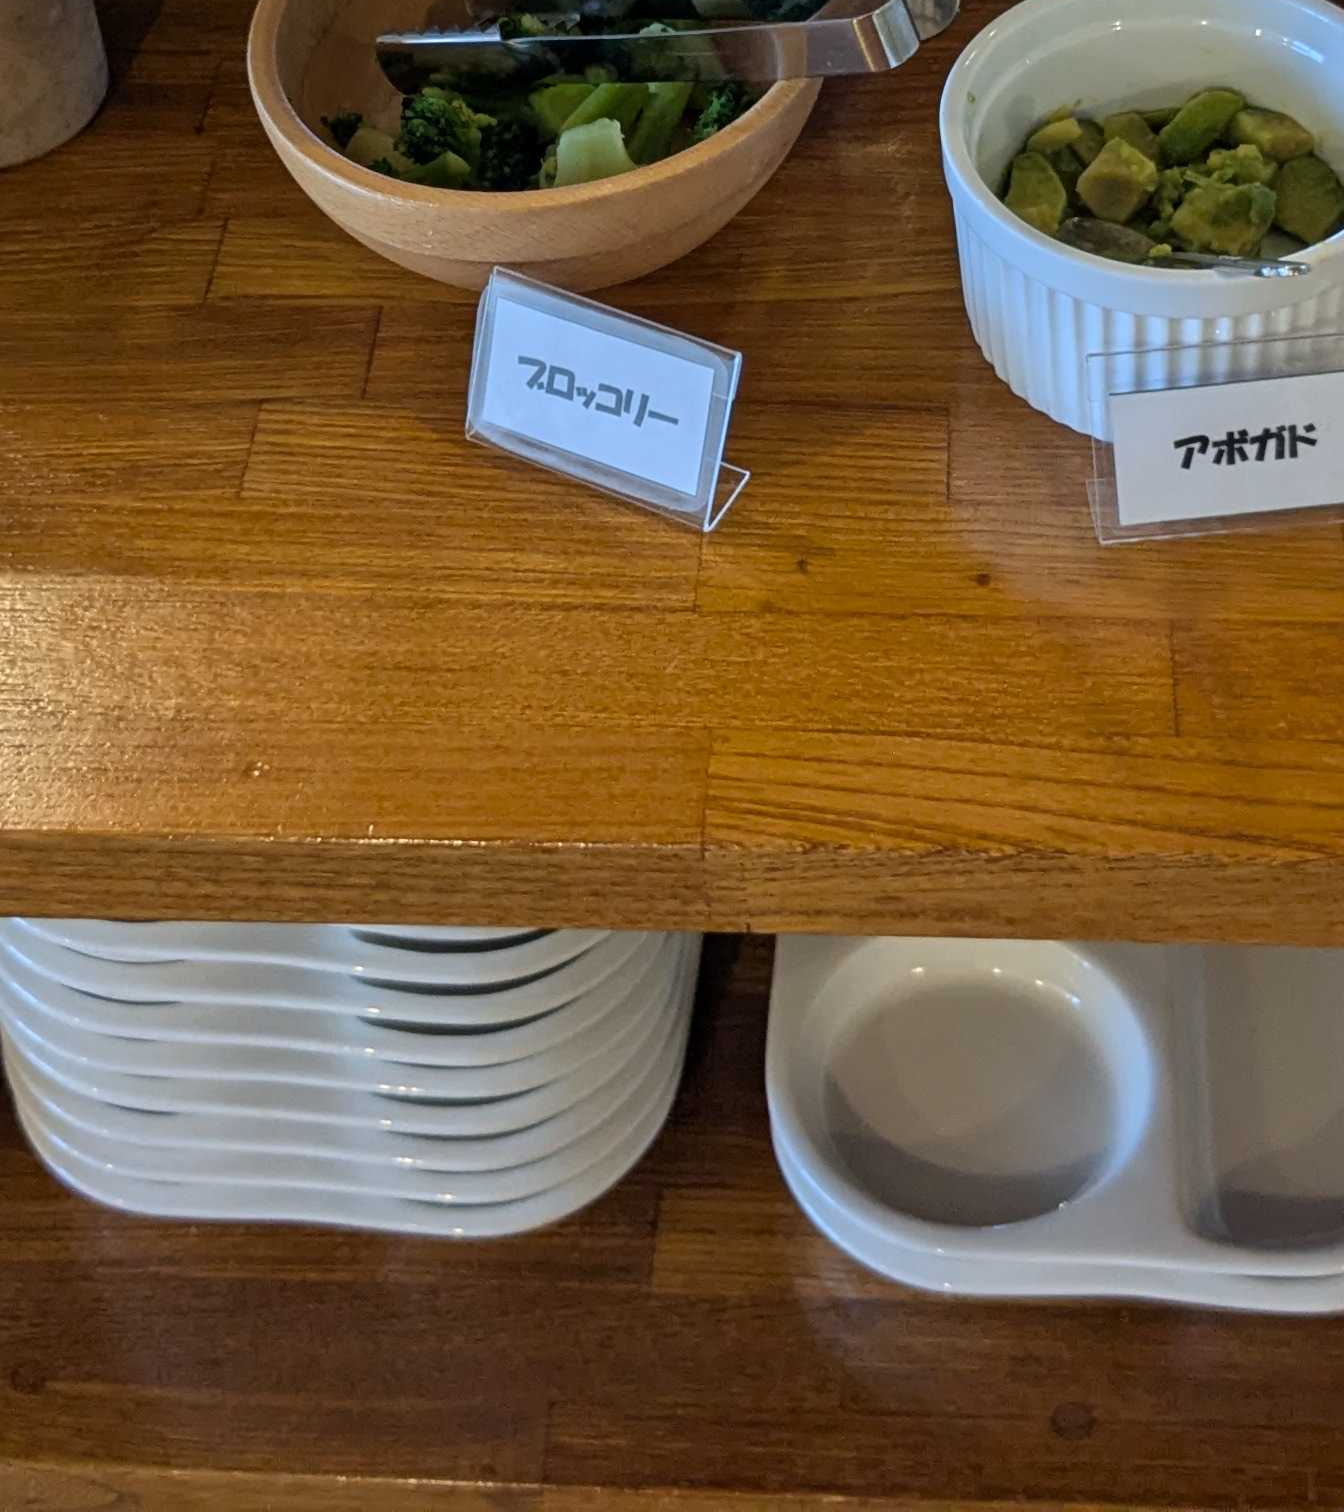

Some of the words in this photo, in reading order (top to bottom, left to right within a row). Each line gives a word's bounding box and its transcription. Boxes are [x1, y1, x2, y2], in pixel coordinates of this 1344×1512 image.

[517, 354, 680, 428] ブロッコリー
[1173, 422, 1318, 470] アボガド
